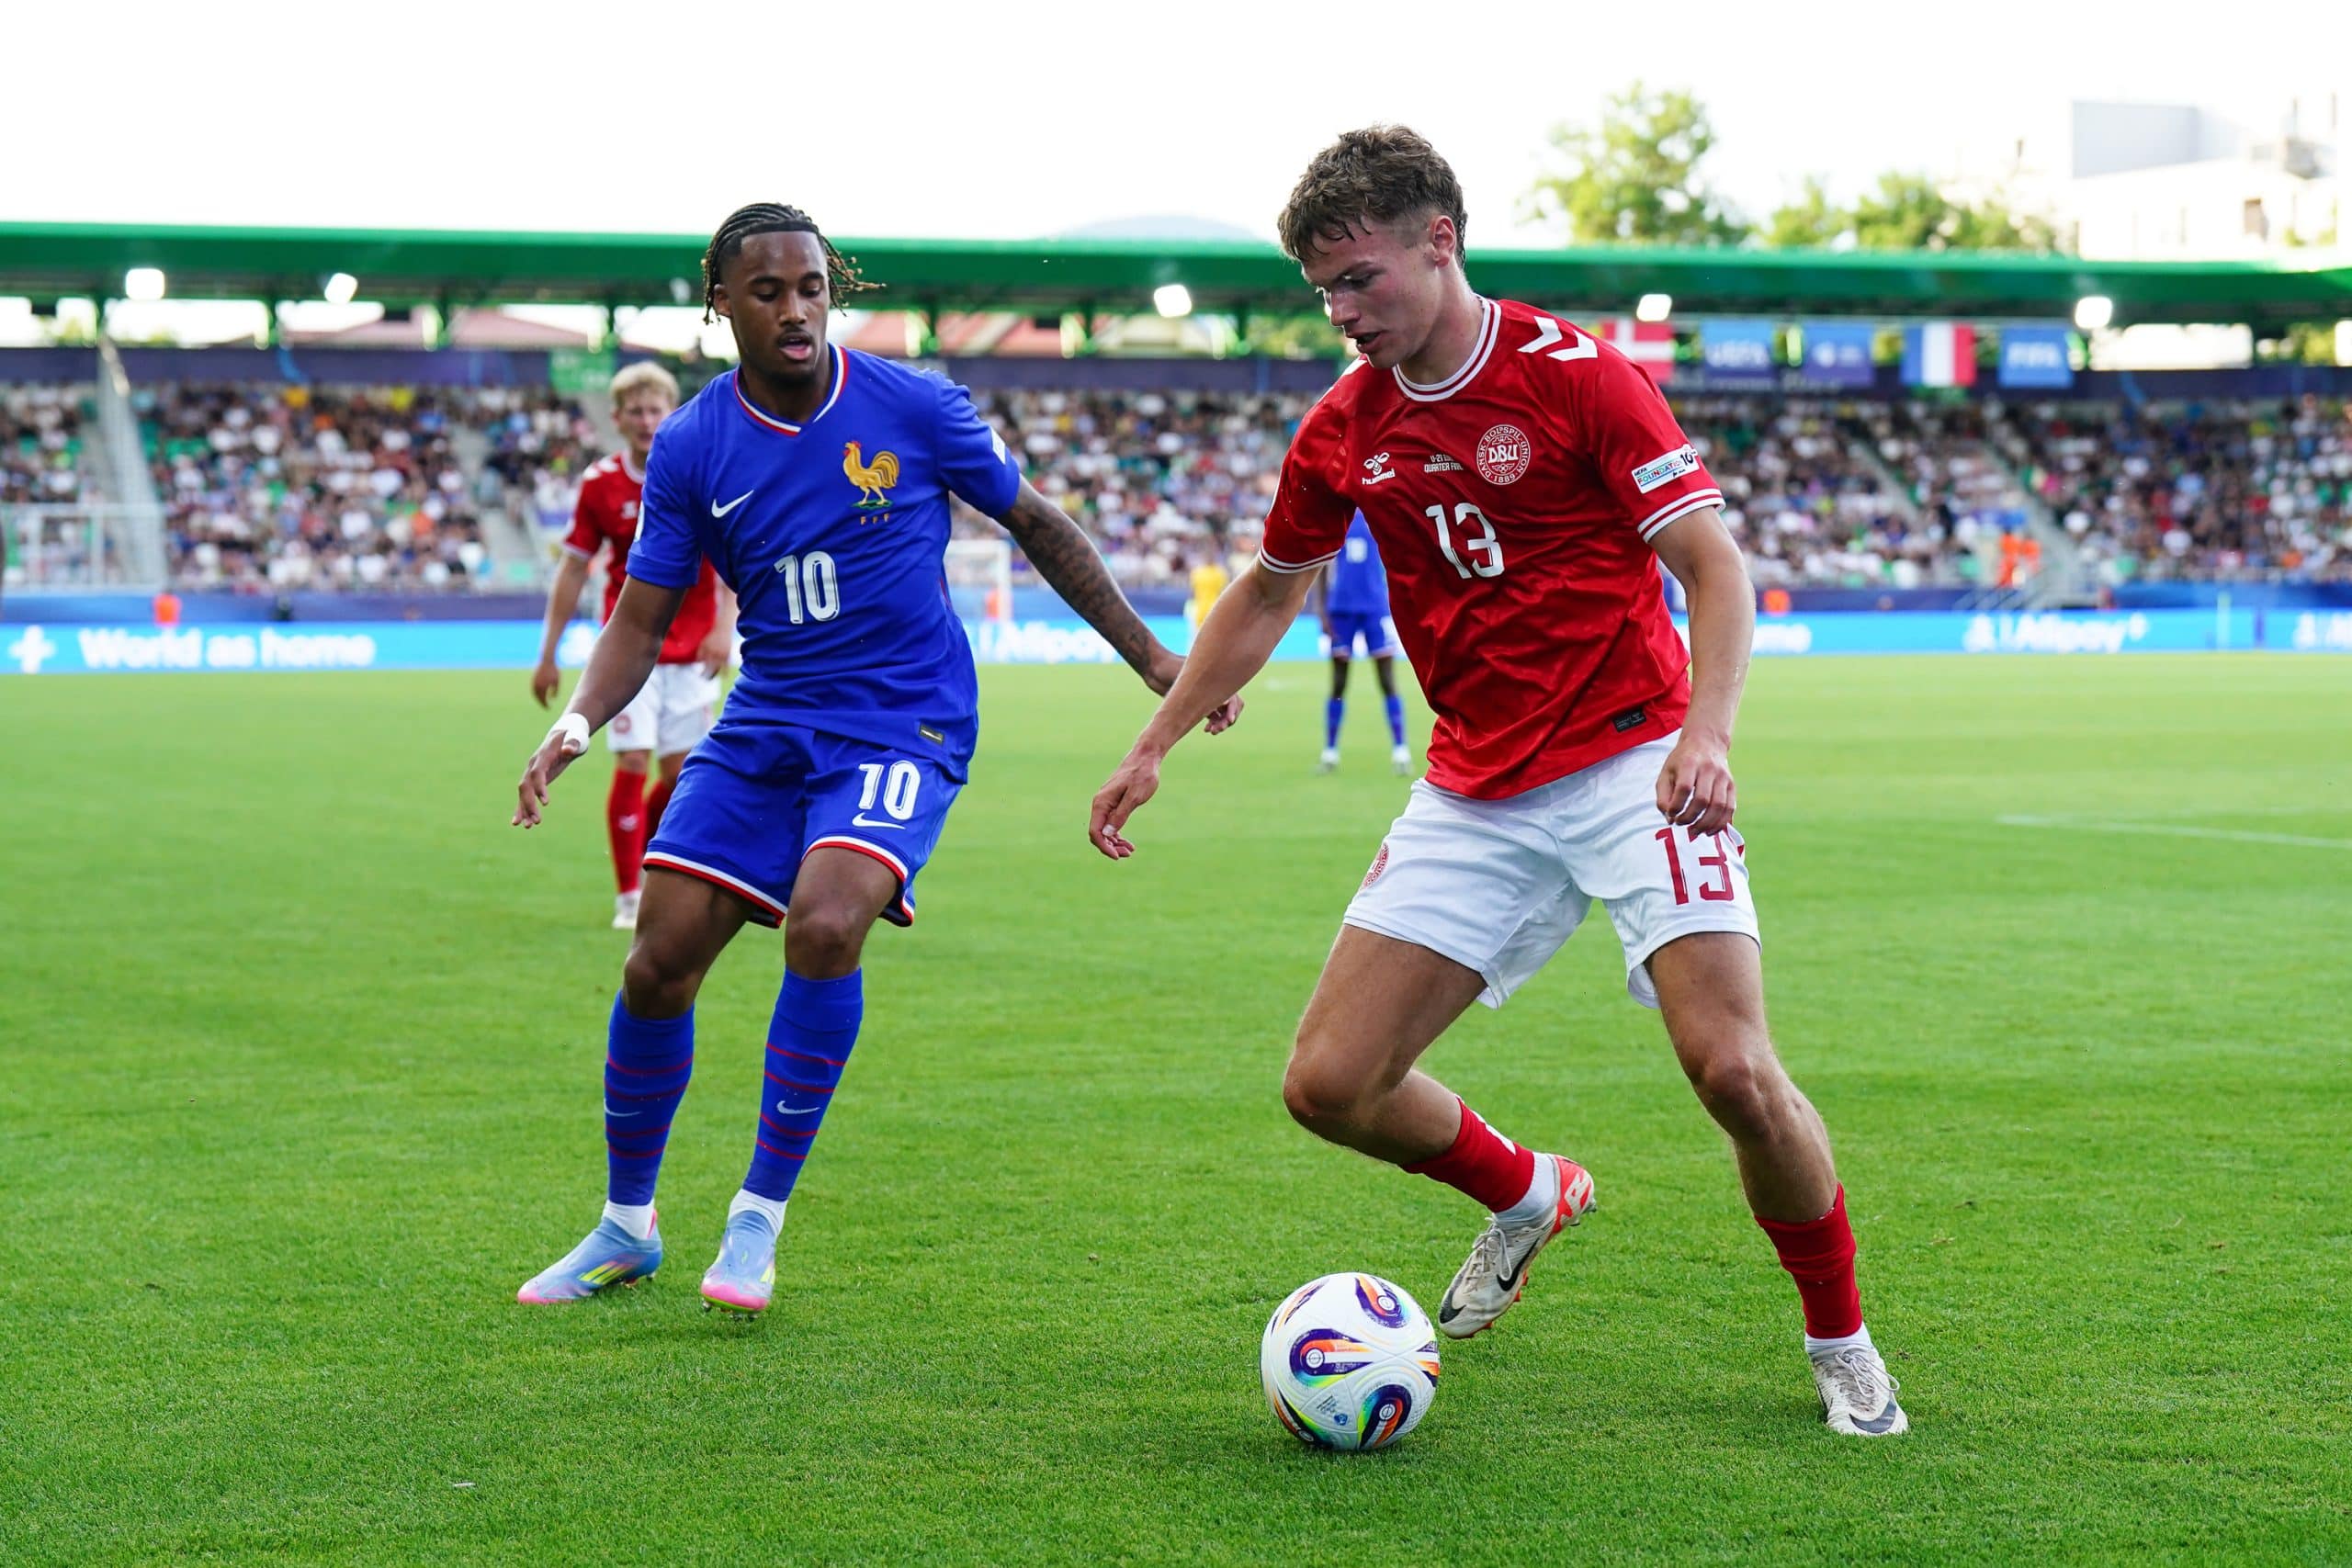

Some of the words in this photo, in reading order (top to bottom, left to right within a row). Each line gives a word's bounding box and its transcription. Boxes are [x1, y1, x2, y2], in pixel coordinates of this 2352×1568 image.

[1424, 463, 1451, 473] QUARTER
[1488, 445, 1519, 464] DBU
[1517, 441, 1529, 473] UNION
[1362, 467, 1396, 485] hummel
[1425, 502, 1505, 579] 13
[774, 551, 841, 625] 10
[78, 627, 202, 668] World
[206, 635, 257, 667] as
[260, 626, 377, 667] home
[858, 760, 921, 820] 10
[1655, 823, 1735, 905] 13
